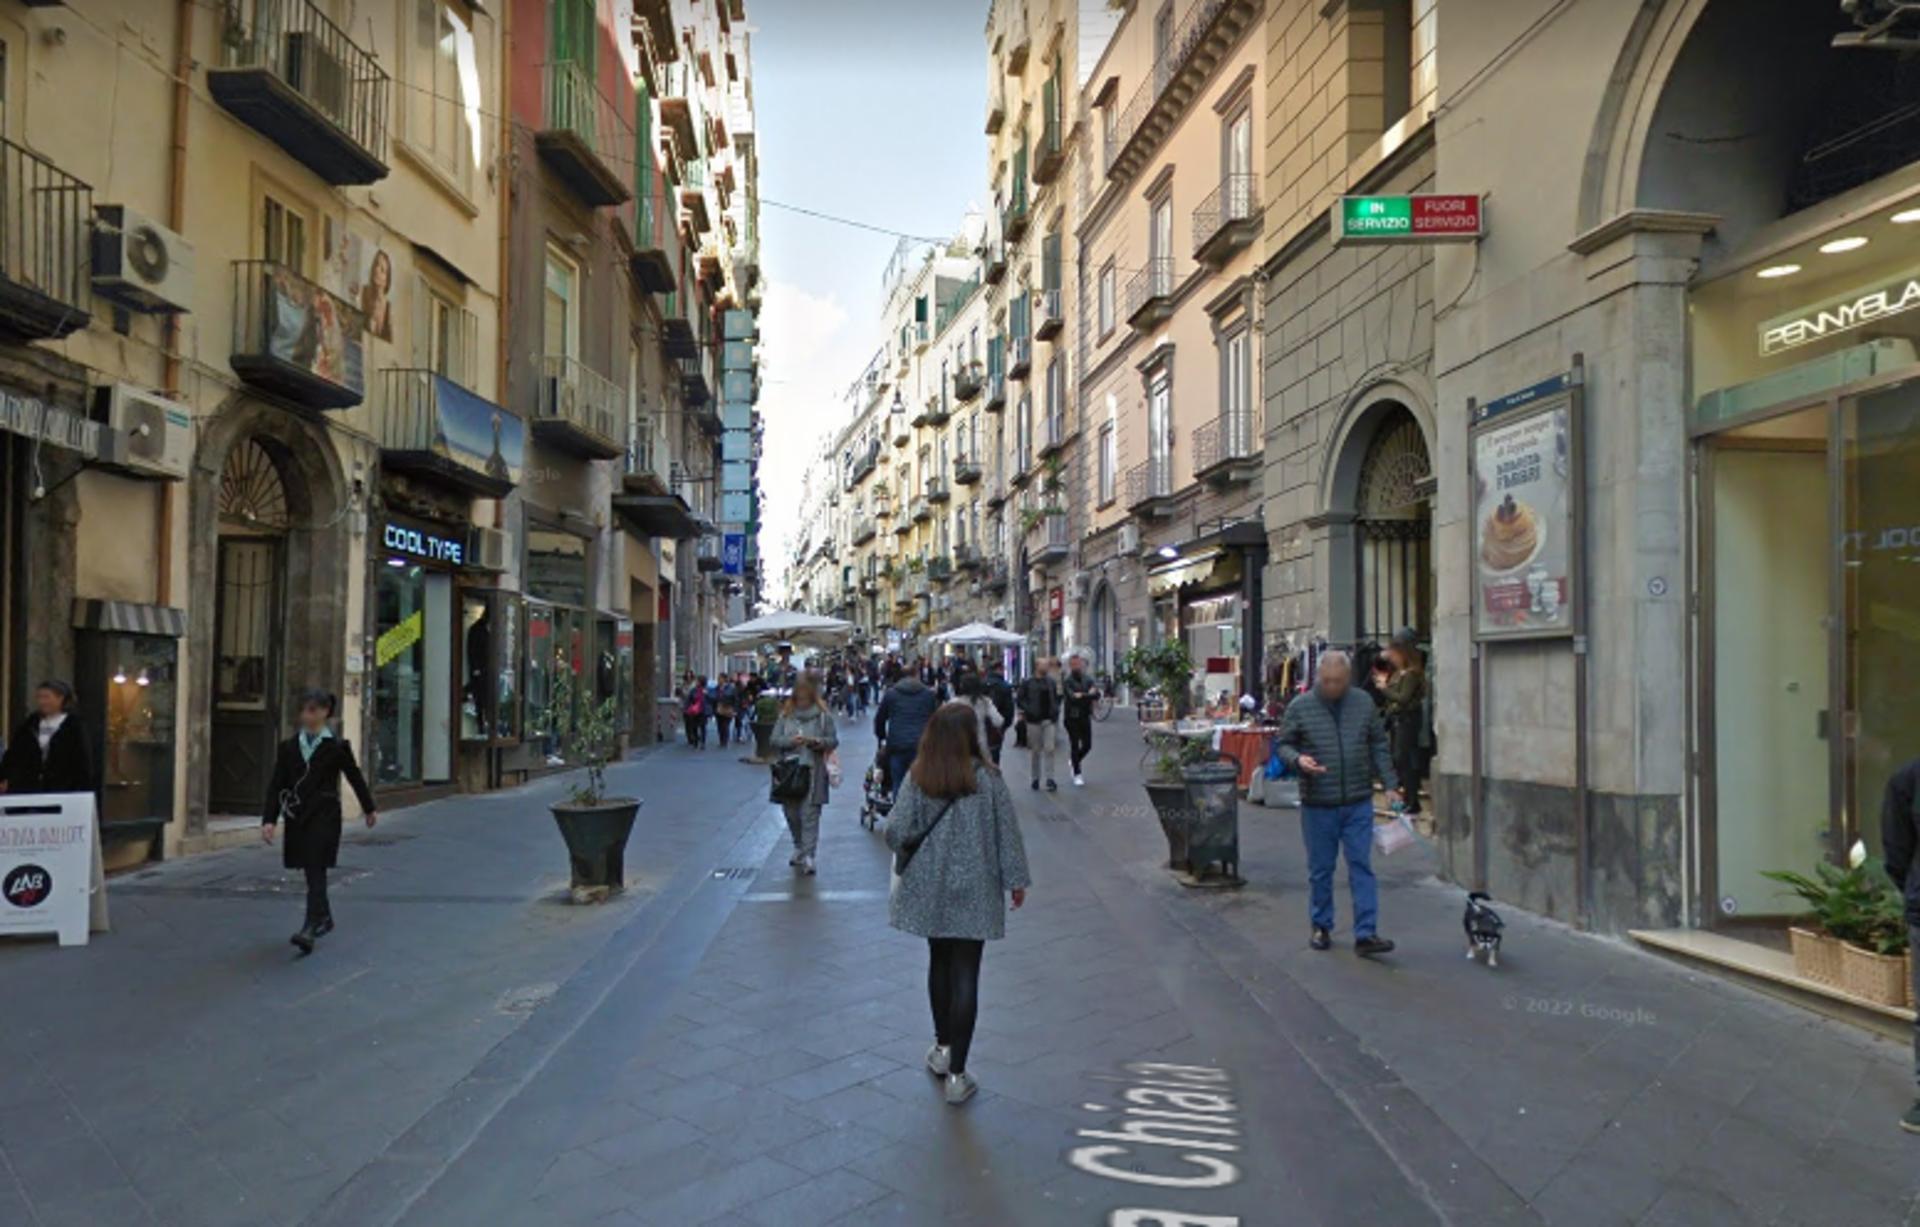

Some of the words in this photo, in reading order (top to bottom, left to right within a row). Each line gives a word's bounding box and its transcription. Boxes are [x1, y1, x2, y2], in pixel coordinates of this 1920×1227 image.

[1369, 202, 1385, 214] IN
[1424, 200, 1467, 212] FUORI
[1347, 217, 1409, 231] SERVIZIO
[1414, 215, 1476, 229] SERVIZIO
[384, 524, 426, 556] COOL
[427, 536, 462, 566] TYPE
